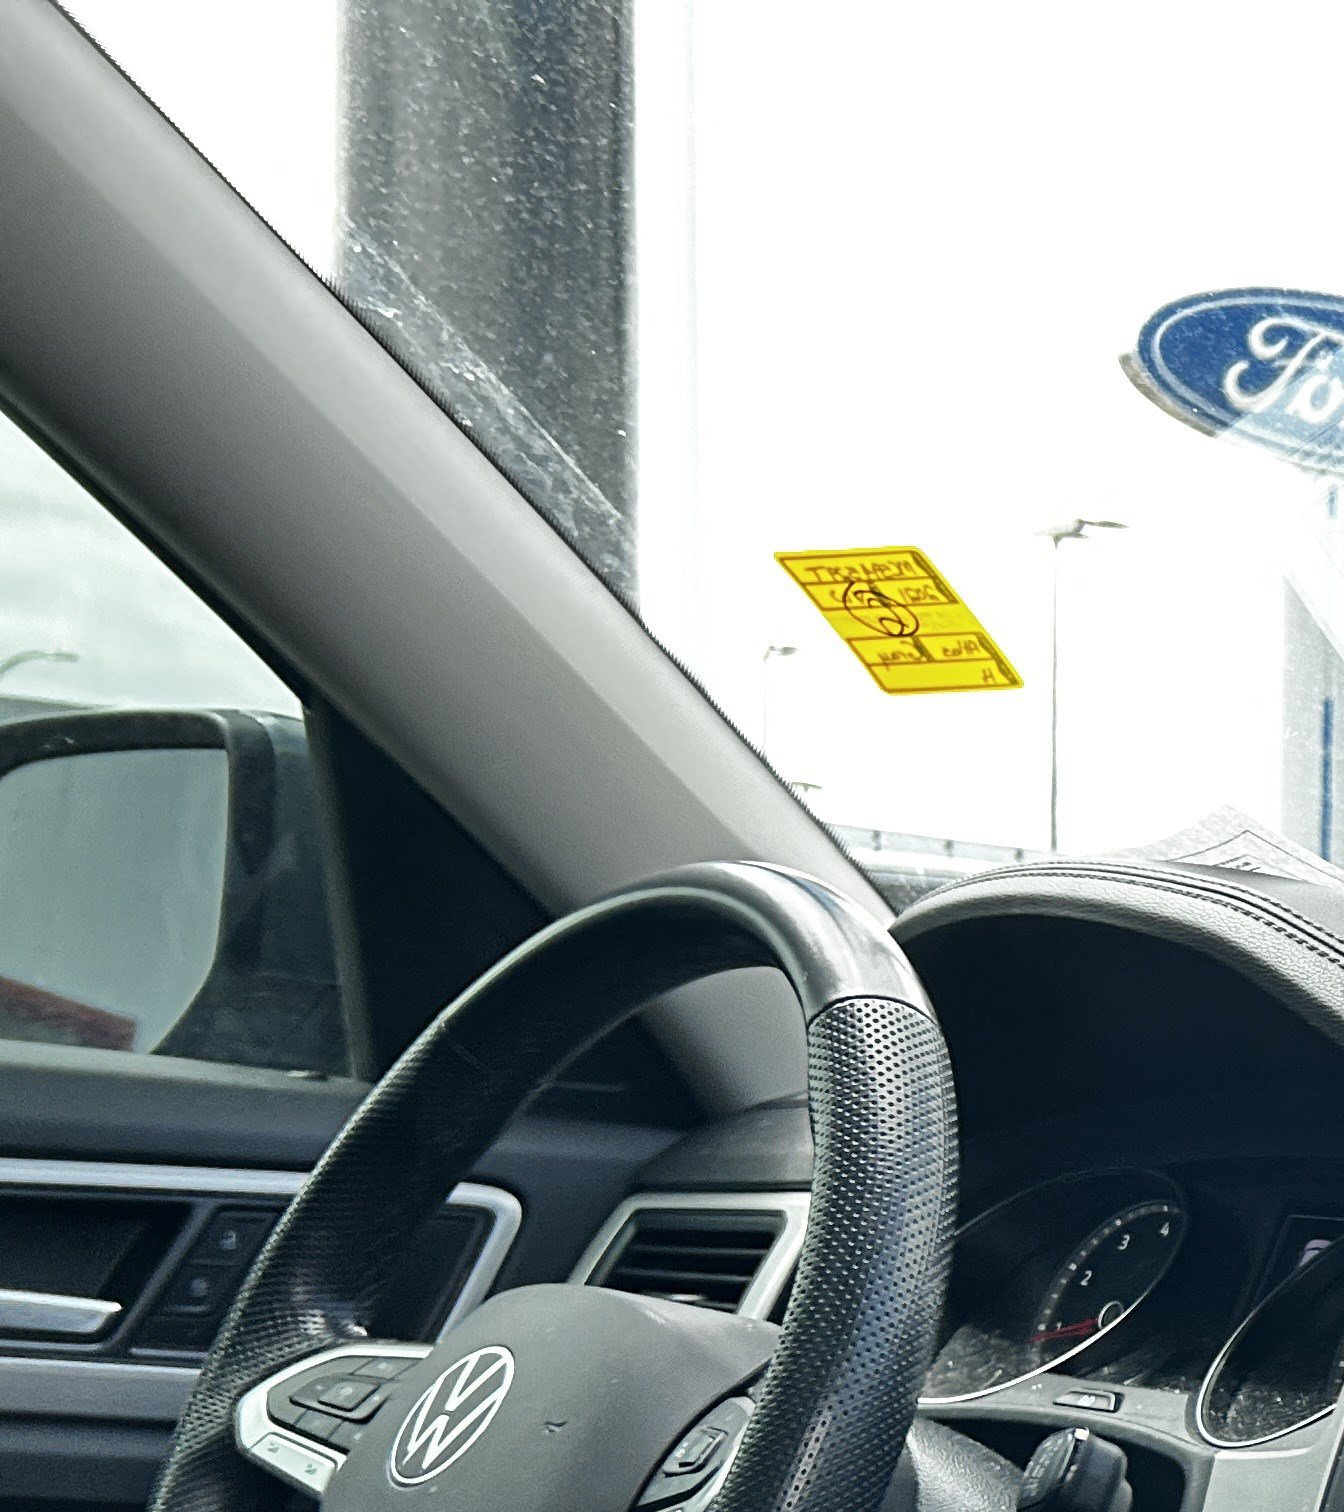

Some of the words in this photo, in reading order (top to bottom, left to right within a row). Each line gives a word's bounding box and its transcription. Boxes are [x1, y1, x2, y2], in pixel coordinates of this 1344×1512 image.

[1160, 1222, 1170, 1236] 4
[1117, 1234, 1131, 1250] 3
[1080, 1270, 1093, 1286] 2
